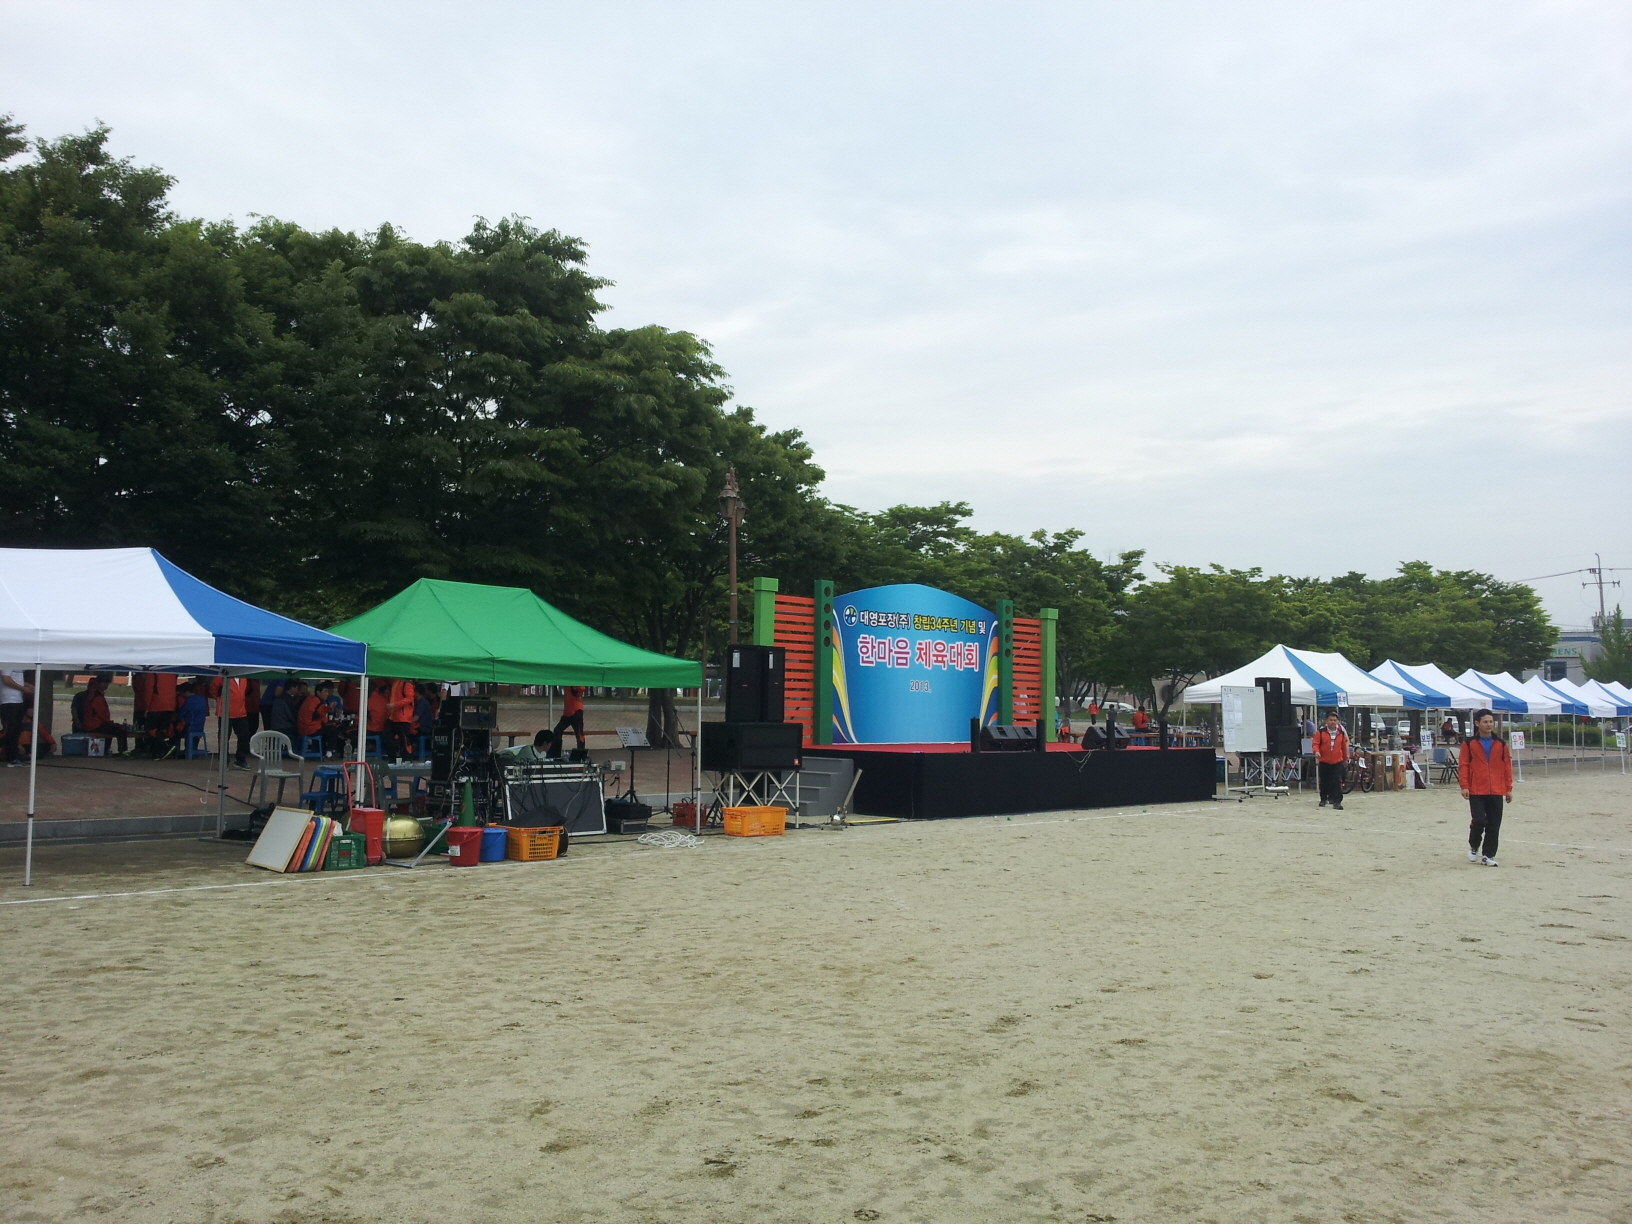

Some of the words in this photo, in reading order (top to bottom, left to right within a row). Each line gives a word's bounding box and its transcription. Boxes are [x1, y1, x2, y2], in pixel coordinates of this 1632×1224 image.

[859, 610, 911, 630] 대영포장(주)
[913, 614, 958, 633] 창립34주년
[960, 619, 977, 634] 기념
[978, 621, 986, 635] 및
[857, 634, 911, 667] 한마음
[915, 639, 980, 671] 체육대회
